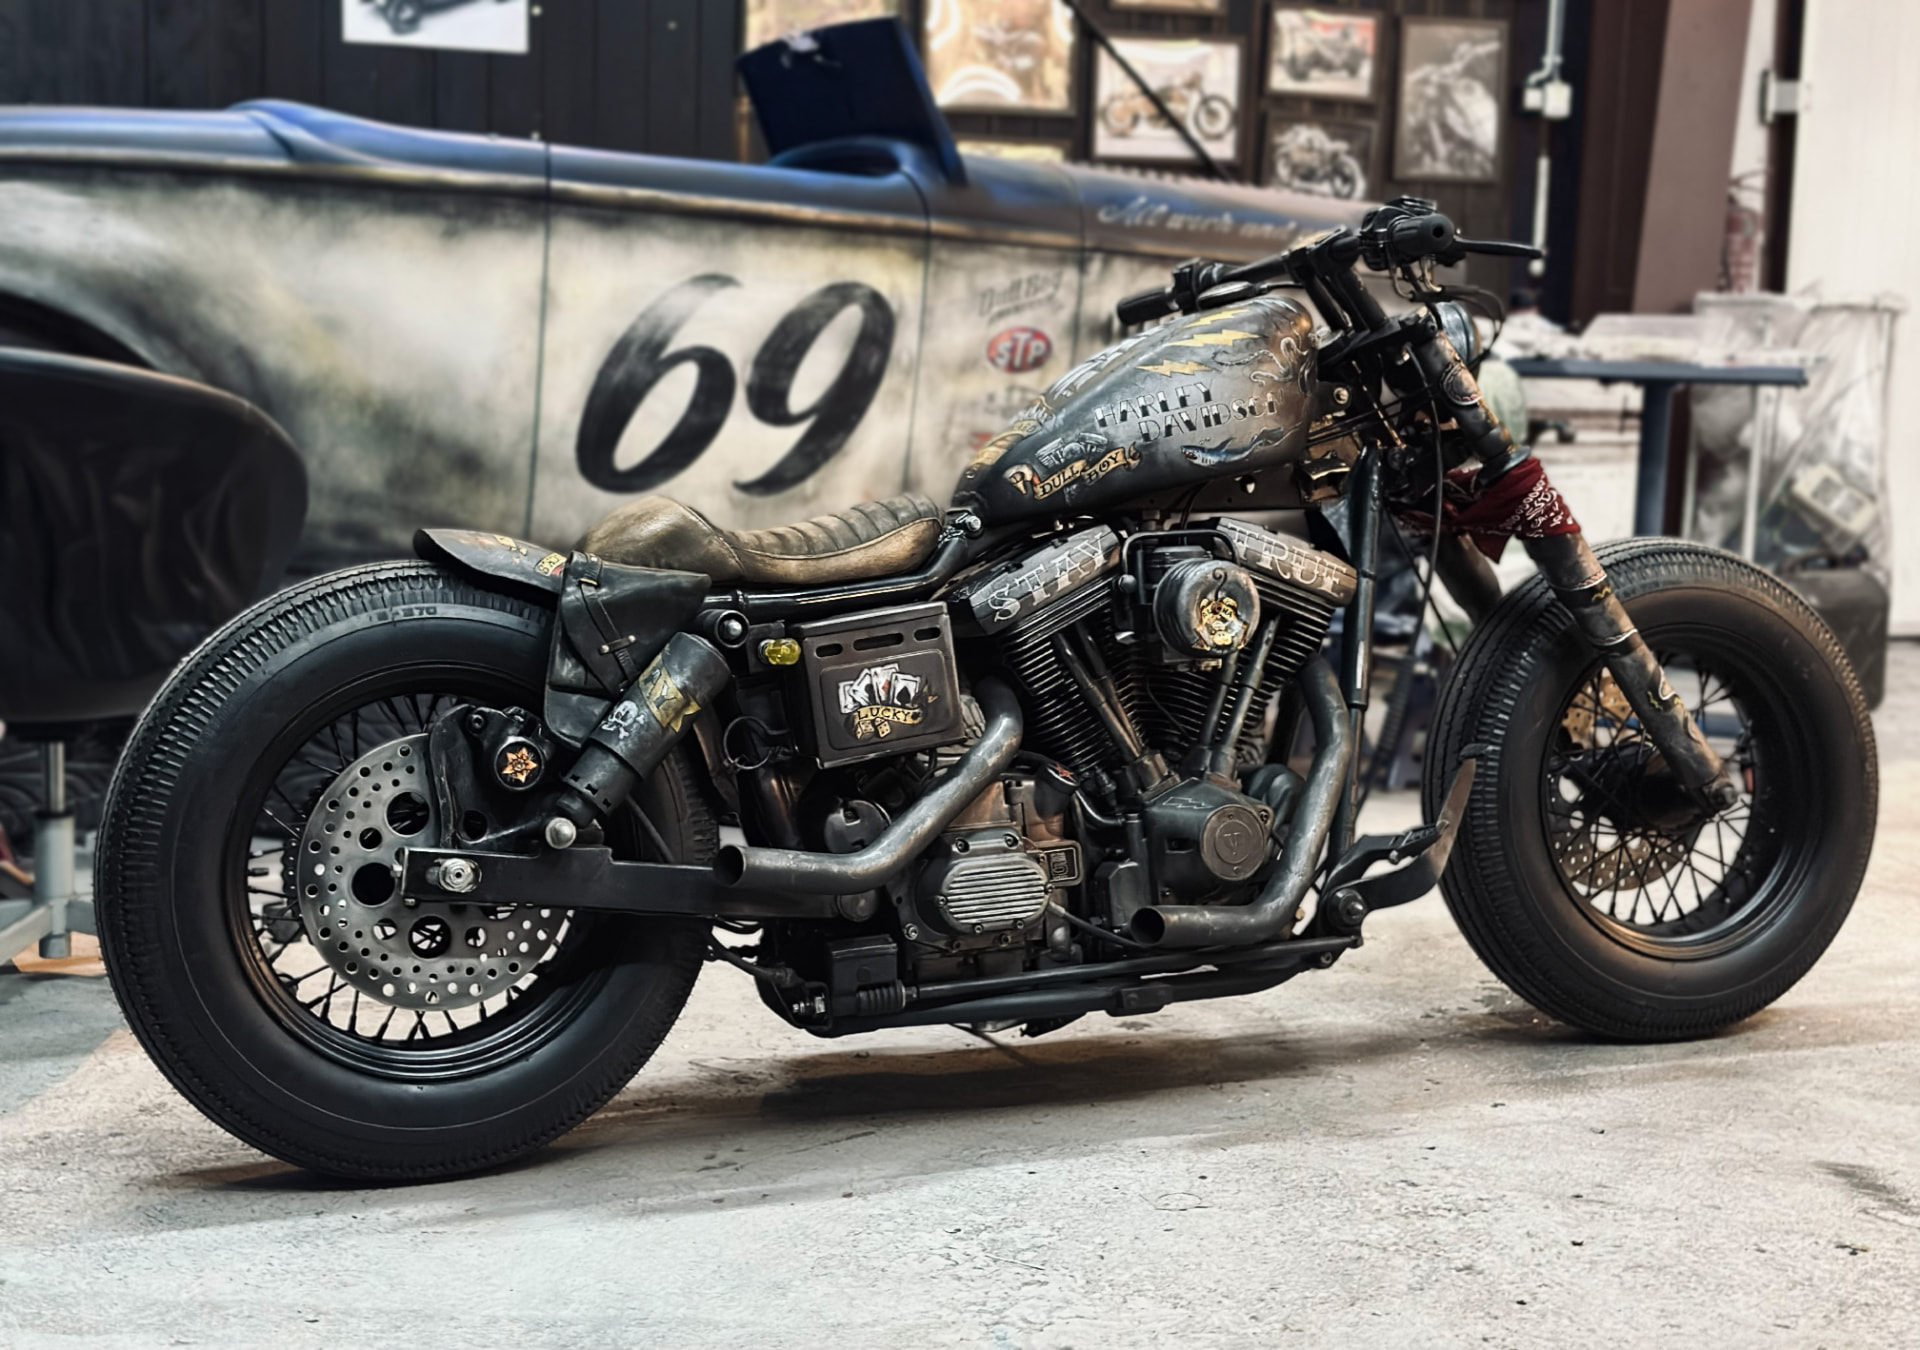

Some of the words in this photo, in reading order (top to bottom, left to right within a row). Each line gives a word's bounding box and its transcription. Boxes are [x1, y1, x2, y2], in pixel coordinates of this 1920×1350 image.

[995, 332, 1047, 368] STP
[576, 273, 894, 496] 69
[1095, 380, 1214, 428] HARLEY
[1139, 390, 1286, 442] DAVIDSON
[1040, 465, 1080, 496] DULL
[1087, 451, 1120, 482] BOY
[988, 532, 1107, 622] STAY
[1228, 522, 1348, 598] TRUE
[857, 707, 911, 721] LUCKY
